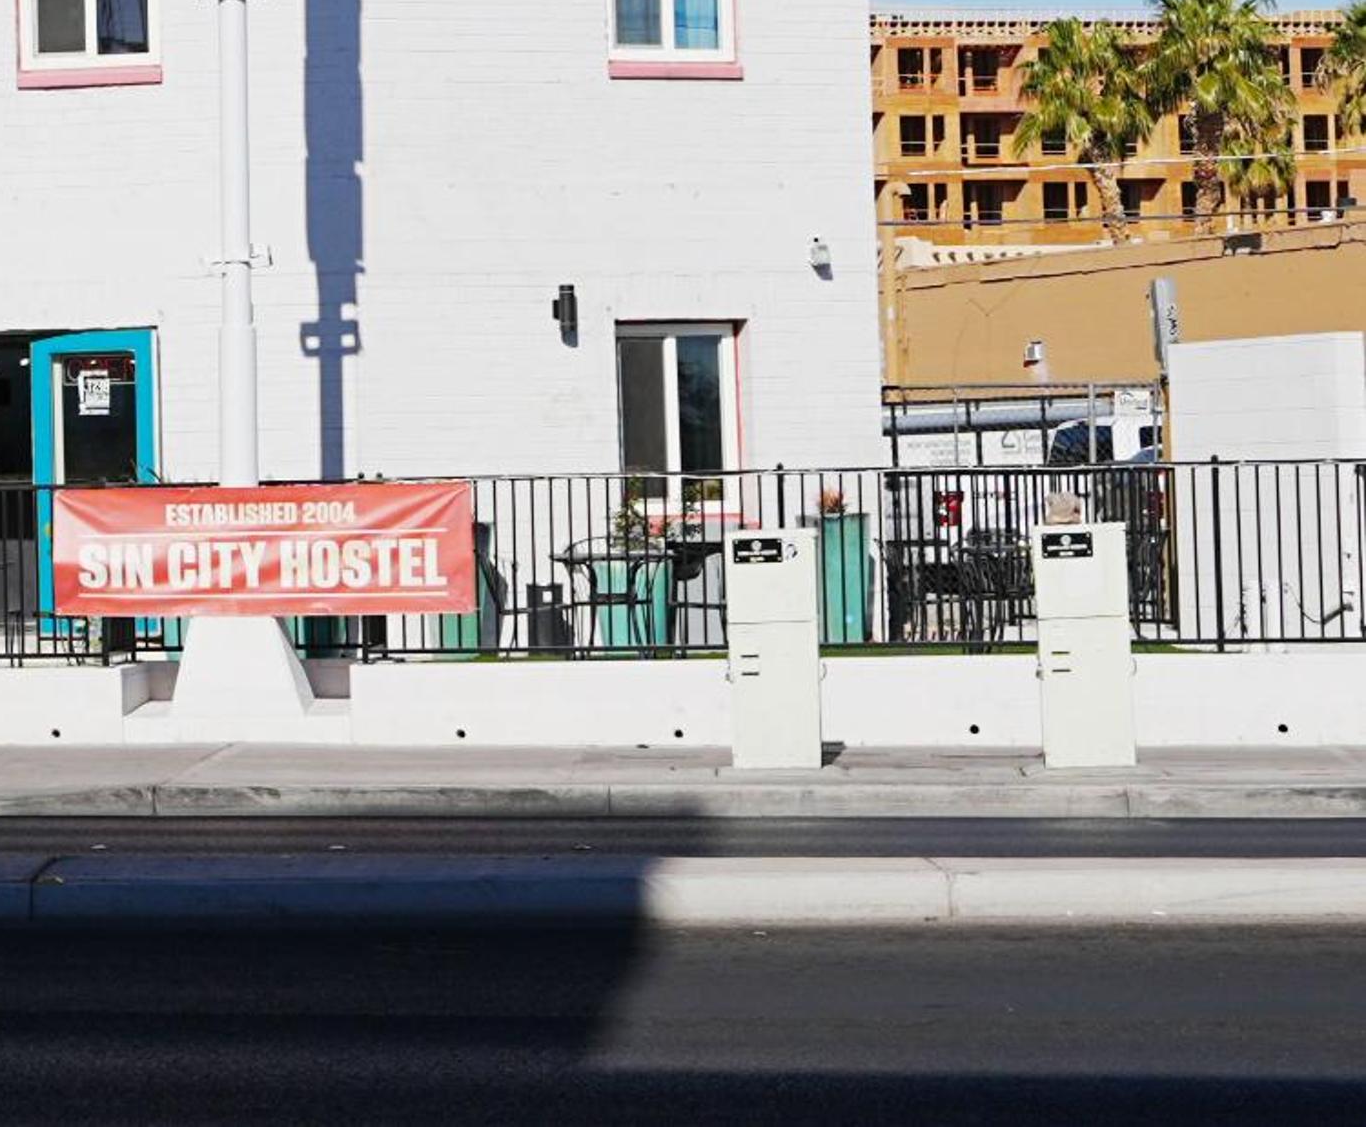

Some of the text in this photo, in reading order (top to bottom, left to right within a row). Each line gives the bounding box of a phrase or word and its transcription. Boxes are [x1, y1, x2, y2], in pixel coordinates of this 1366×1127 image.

[165, 501, 355, 527] ESTABLISHED 2004
[77, 538, 448, 590] SIN CITY HOSTEL
